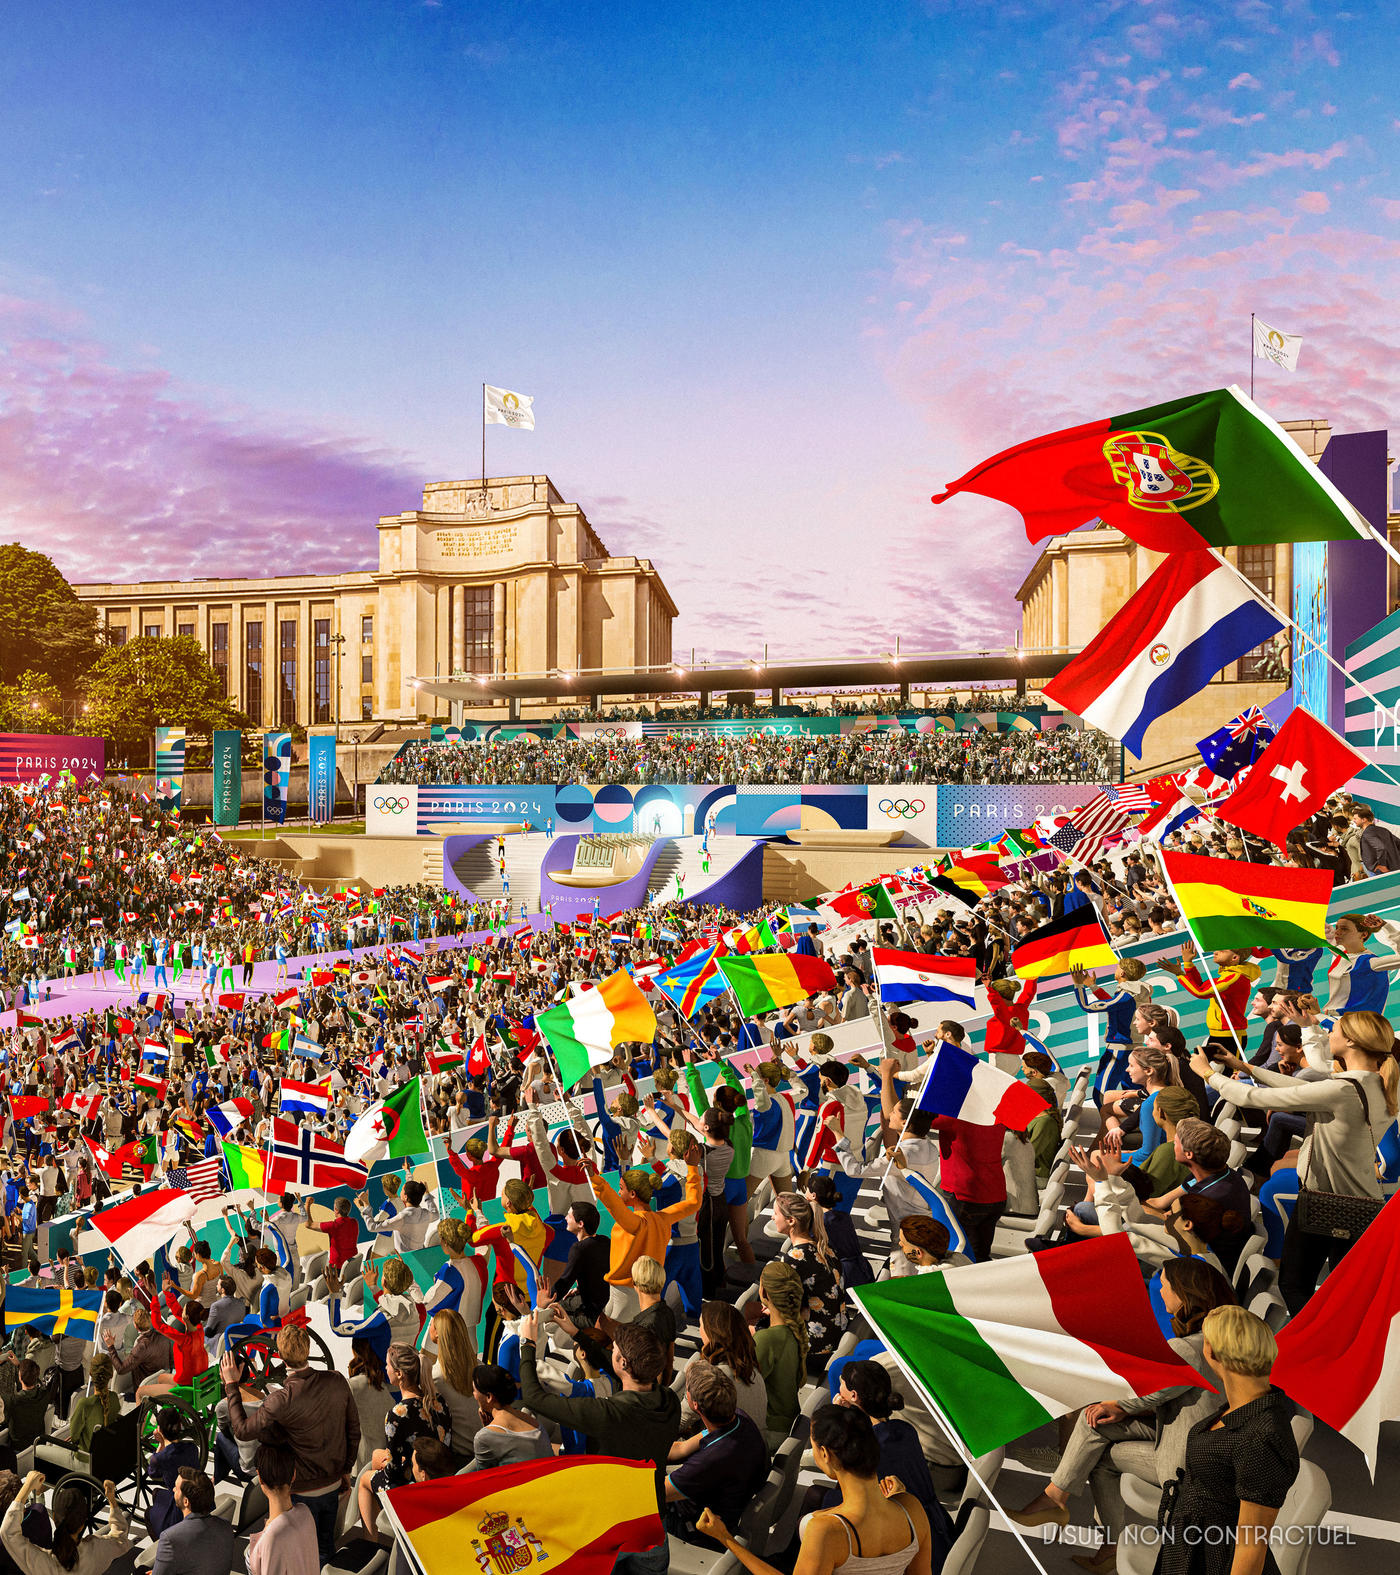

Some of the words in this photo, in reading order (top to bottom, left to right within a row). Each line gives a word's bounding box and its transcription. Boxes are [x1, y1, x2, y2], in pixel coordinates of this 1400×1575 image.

[62, 757, 97, 769] 2024
[223, 746, 232, 776] 2024
[492, 801, 541, 814] 2024
